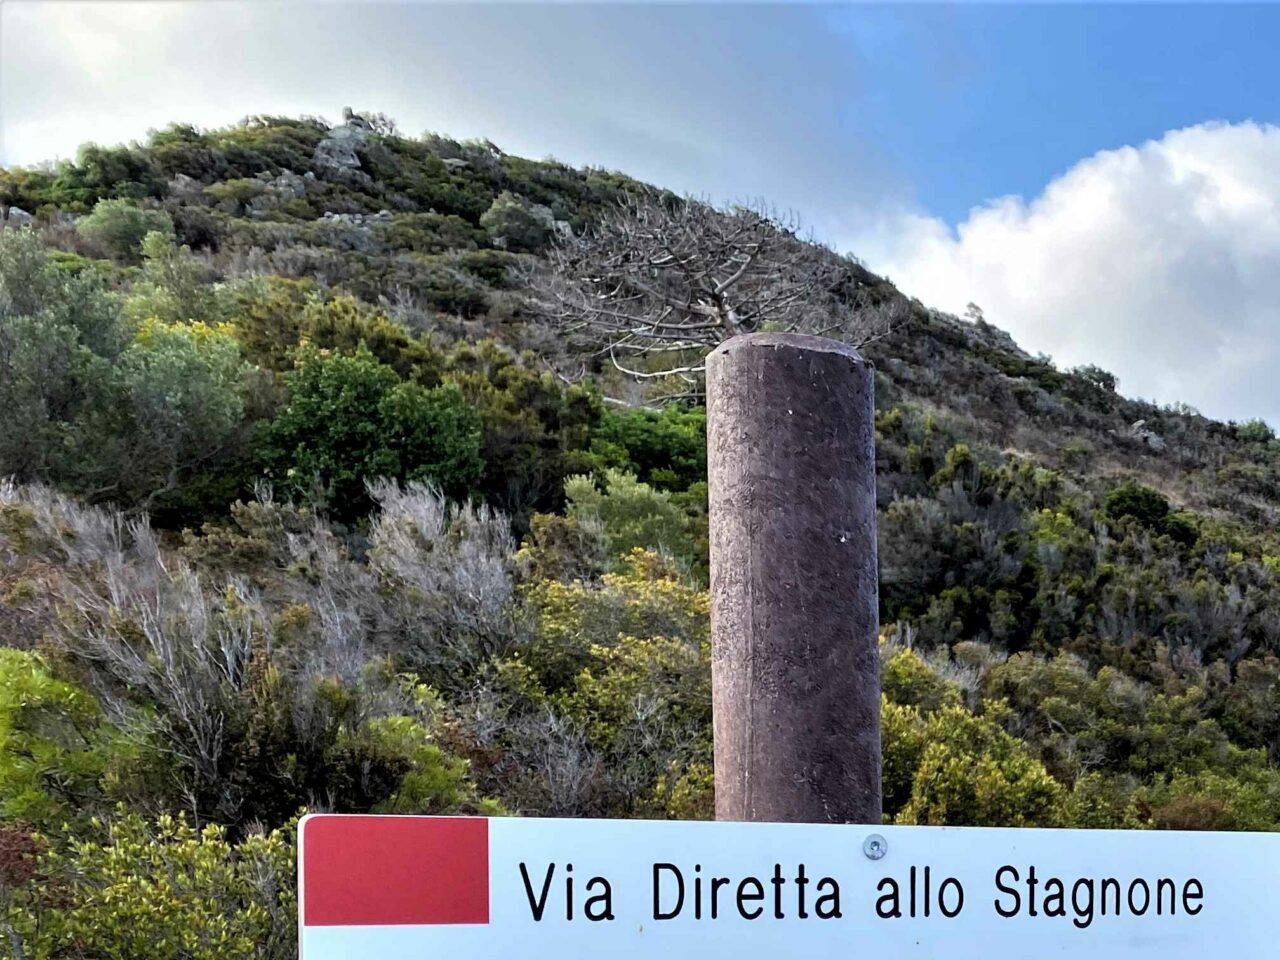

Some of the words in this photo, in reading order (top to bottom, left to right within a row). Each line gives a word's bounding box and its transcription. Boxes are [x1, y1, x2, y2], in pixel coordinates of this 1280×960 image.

[519, 863, 614, 921] Via
[653, 863, 842, 920] Diretta
[876, 866, 963, 918] allo
[995, 865, 1203, 928] Stagnone
